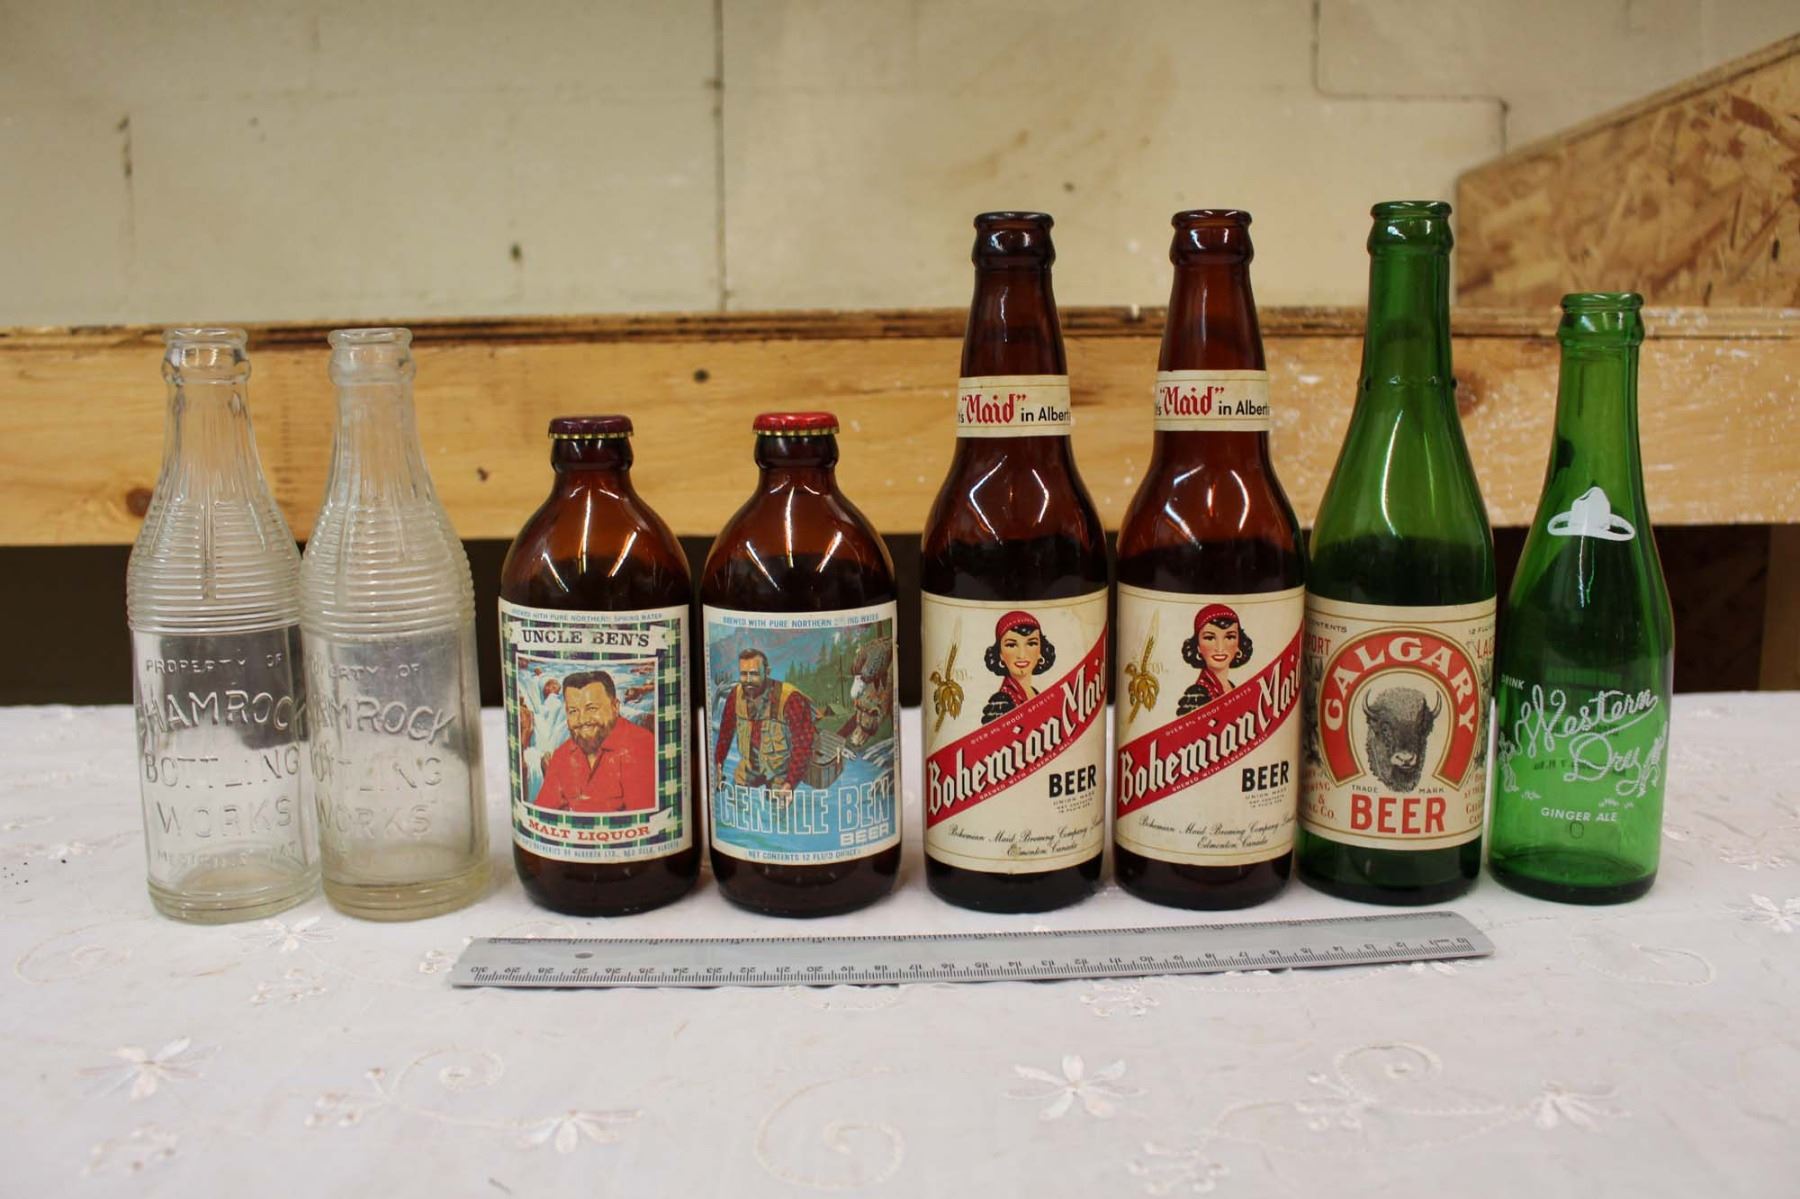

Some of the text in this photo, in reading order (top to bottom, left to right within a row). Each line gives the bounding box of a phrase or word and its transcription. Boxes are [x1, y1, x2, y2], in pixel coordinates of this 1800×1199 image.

[961, 393, 1027, 424] "Maid"
[1021, 407, 1034, 422] in
[1160, 386, 1224, 416] "Maid"
[1218, 401, 1232, 415] in
[521, 628, 650, 647] UNCLE BEN'S
[749, 618, 766, 627] WITH
[769, 619, 787, 628] PURE
[791, 618, 832, 628] NORTHERN
[1477, 637, 1495, 659] LAG
[145, 653, 283, 674] PROPERTY OF
[397, 663, 420, 678] OF
[1324, 636, 1474, 733] CALGARY
[1197, 705, 1220, 720] PROOF
[1515, 684, 1658, 758] Western
[928, 715, 1063, 816] Bohemian
[1119, 711, 1257, 806] Bohemian
[1172, 776, 1199, 792] BREWED
[1202, 765, 1221, 778] WITH
[1223, 746, 1251, 766] ALBERTA
[1563, 731, 1642, 796] Dry
[979, 784, 1006, 800] BREWED
[1008, 772, 1027, 785] WITH
[1049, 764, 1097, 799] BEER
[1241, 761, 1290, 793] BEER
[1352, 784, 1445, 795] TRADE MARK
[156, 797, 291, 838] WORKS
[314, 793, 432, 839] WORKS
[719, 776, 890, 835] GENTLE BEN
[1350, 793, 1447, 834] BEER
[1541, 807, 1618, 822] GINGER ALE
[528, 818, 651, 842] MALT LIQUOR
[840, 822, 890, 847] BEER
[763, 851, 800, 862] CONTENTS
